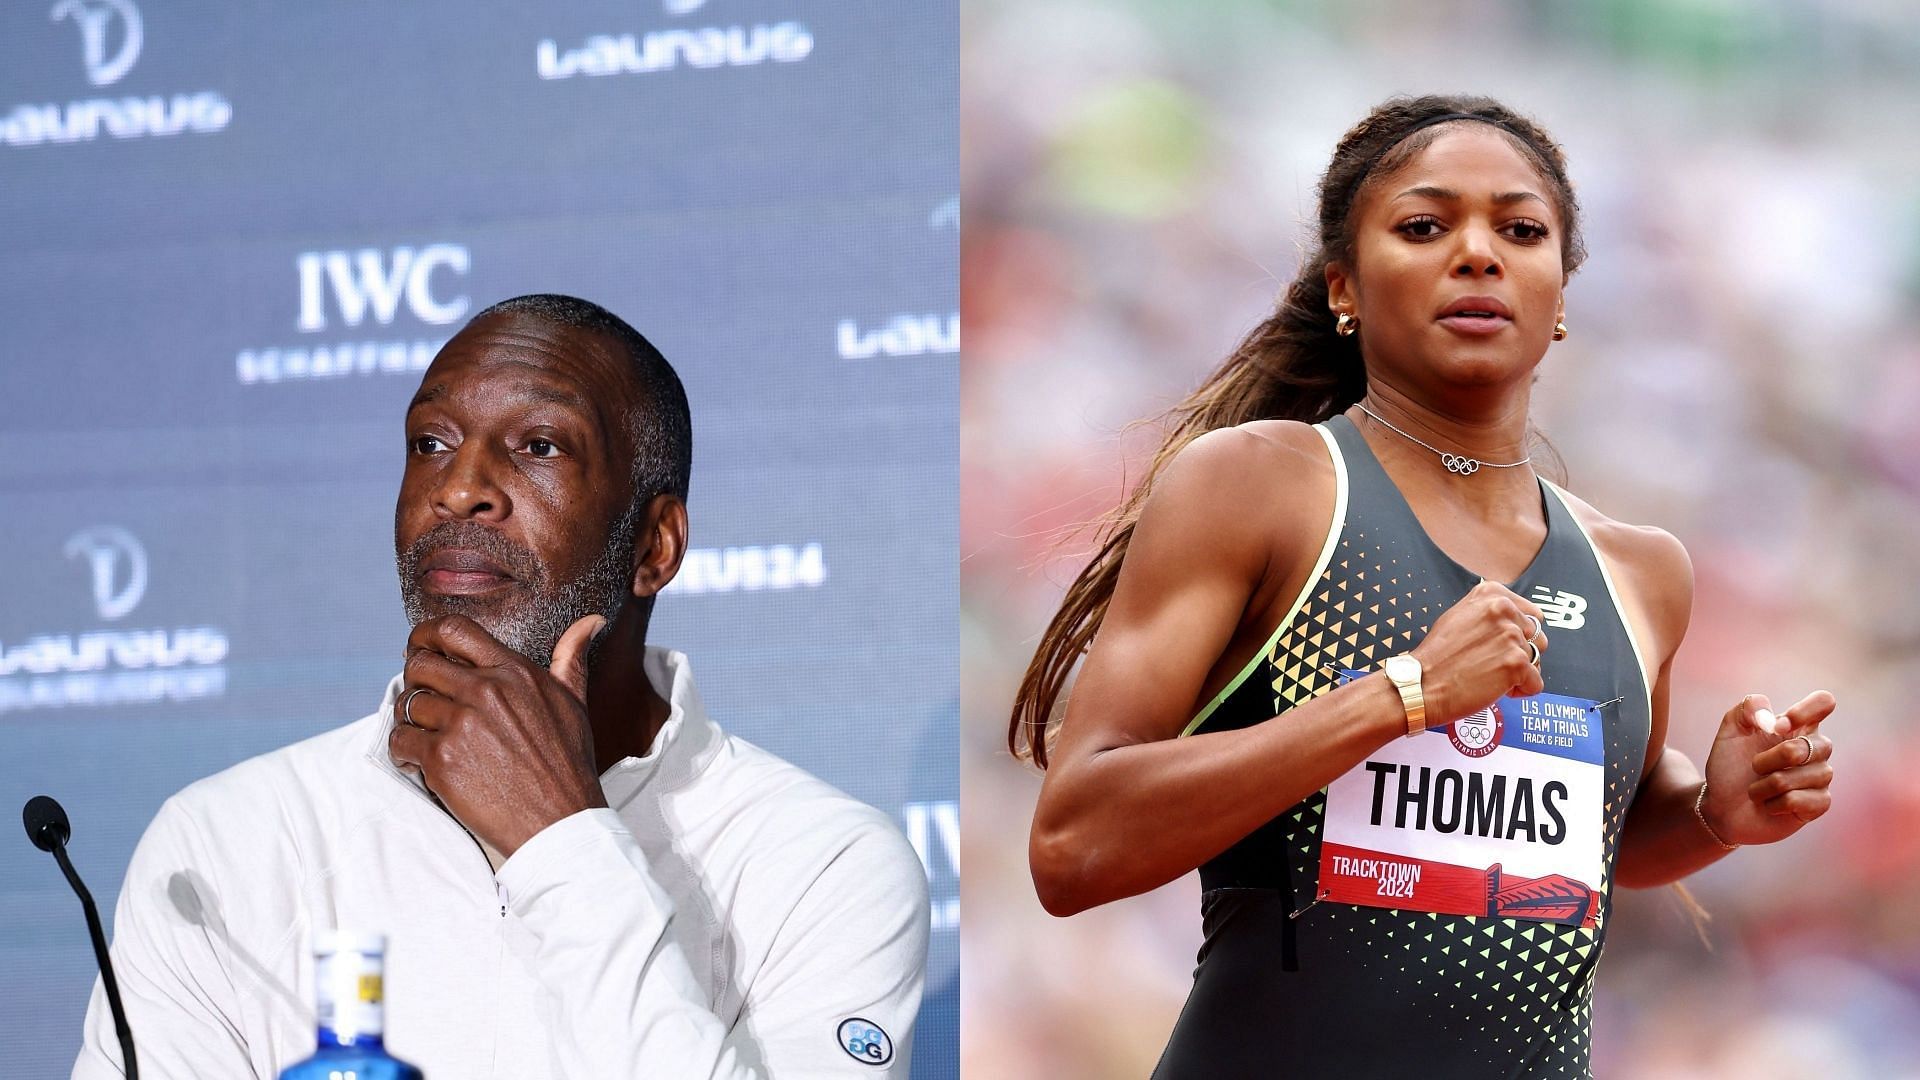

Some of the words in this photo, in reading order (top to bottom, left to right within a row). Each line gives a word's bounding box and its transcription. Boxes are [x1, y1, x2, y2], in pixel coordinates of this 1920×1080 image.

[297, 243, 472, 333] IWC
[1522, 700, 1541, 715] U.S.
[1545, 703, 1586, 722] OLYMPIC
[1522, 716, 1549, 732] TEAM
[1553, 720, 1588, 737] TRIALS
[1452, 737, 1477, 756] OLYMPIC
[1480, 742, 1496, 756] TEAM
[1523, 733, 1546, 744] TRACK
[1555, 736, 1573, 748] FIELD
[1365, 761, 1568, 846] THOMAS
[1333, 856, 1421, 883] TRACKTOWN
[1377, 878, 1414, 898] 2024
